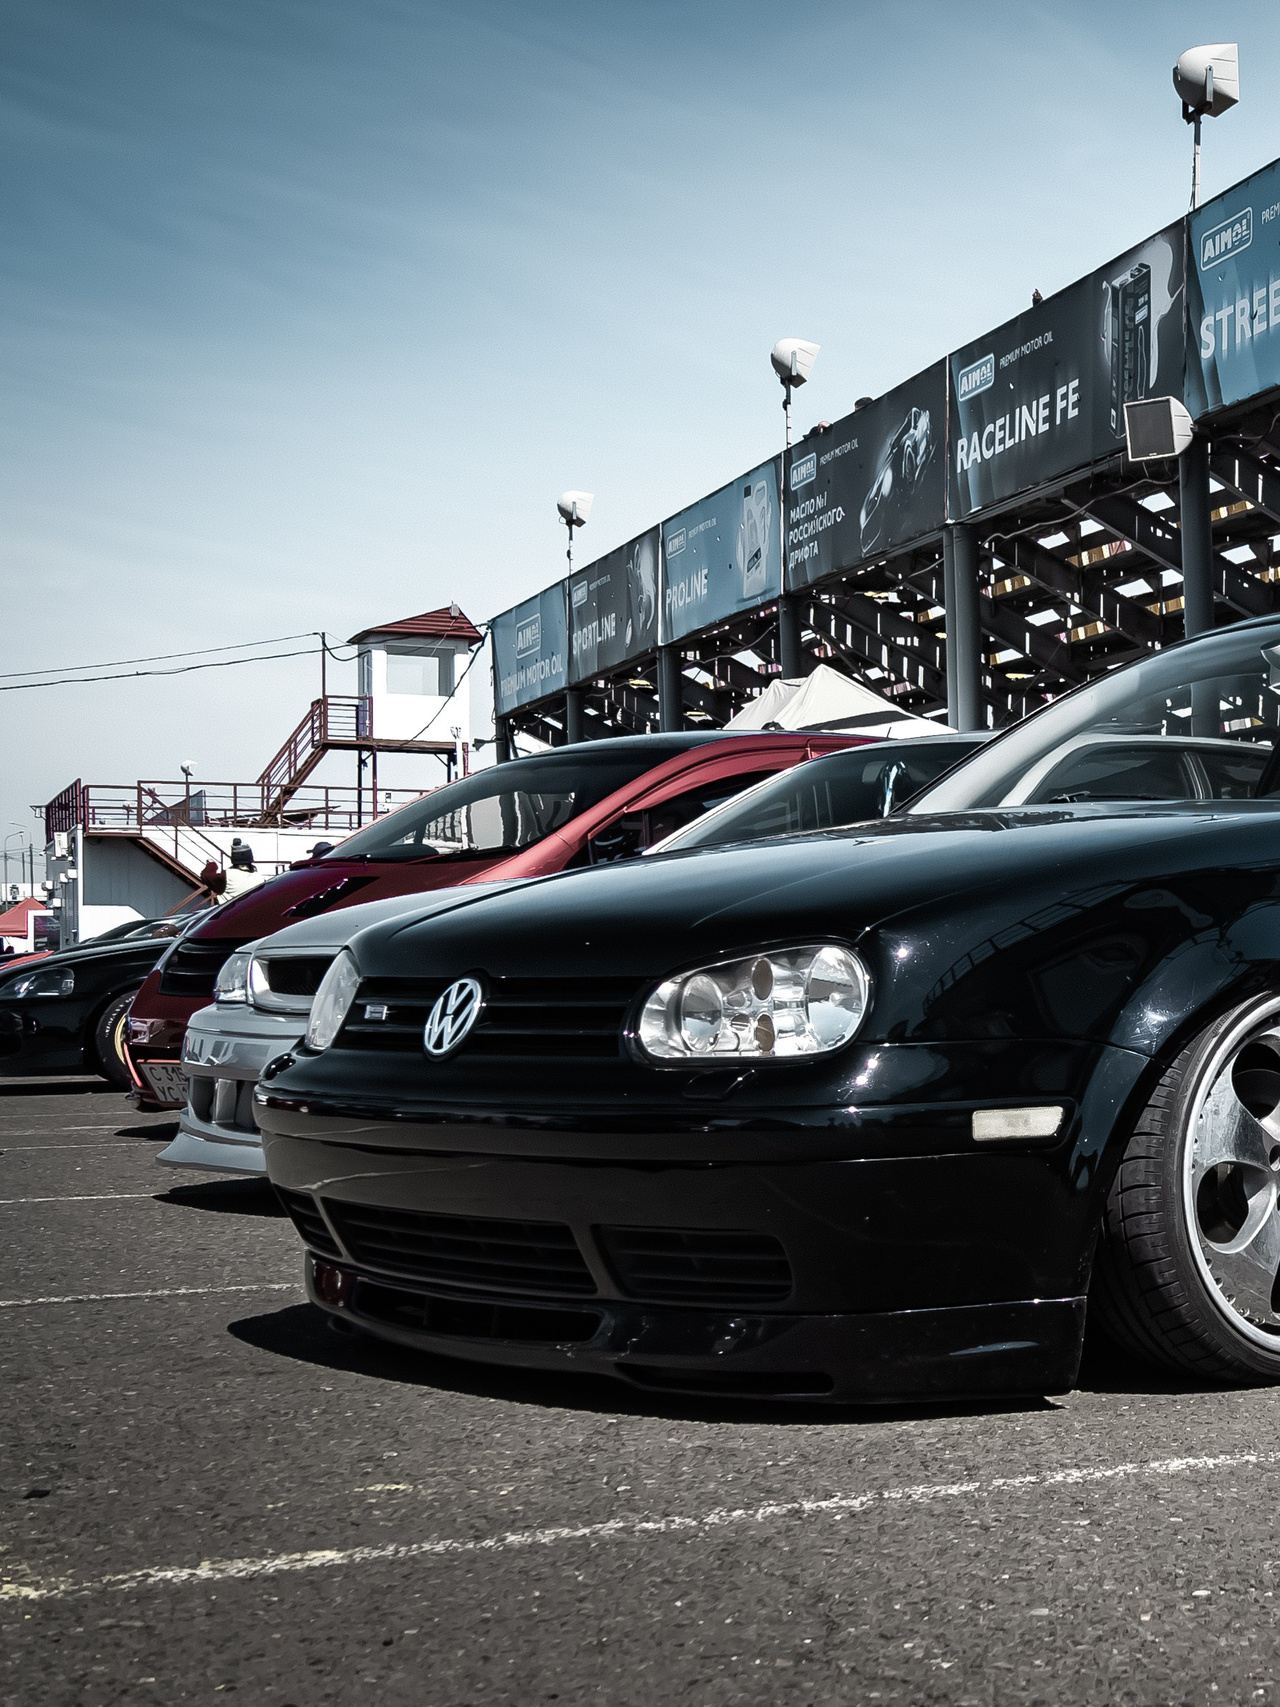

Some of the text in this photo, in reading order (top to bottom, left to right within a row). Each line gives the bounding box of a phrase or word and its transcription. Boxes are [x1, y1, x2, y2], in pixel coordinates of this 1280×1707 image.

[1203, 218, 1250, 263] AIMOL
[999, 330, 1054, 370] PREMIUM MOTOR OIL
[960, 362, 993, 395] AIMOL
[956, 378, 1080, 474] RACELINE FE
[788, 506, 843, 546] РОССИЙСКОГО
[789, 498, 815, 525] МАСЛО
[788, 540, 819, 571] ДРИФТА
[665, 568, 708, 613] PROLINE
[526, 659, 551, 687] MOTOR
[551, 653, 563, 675] OIL
